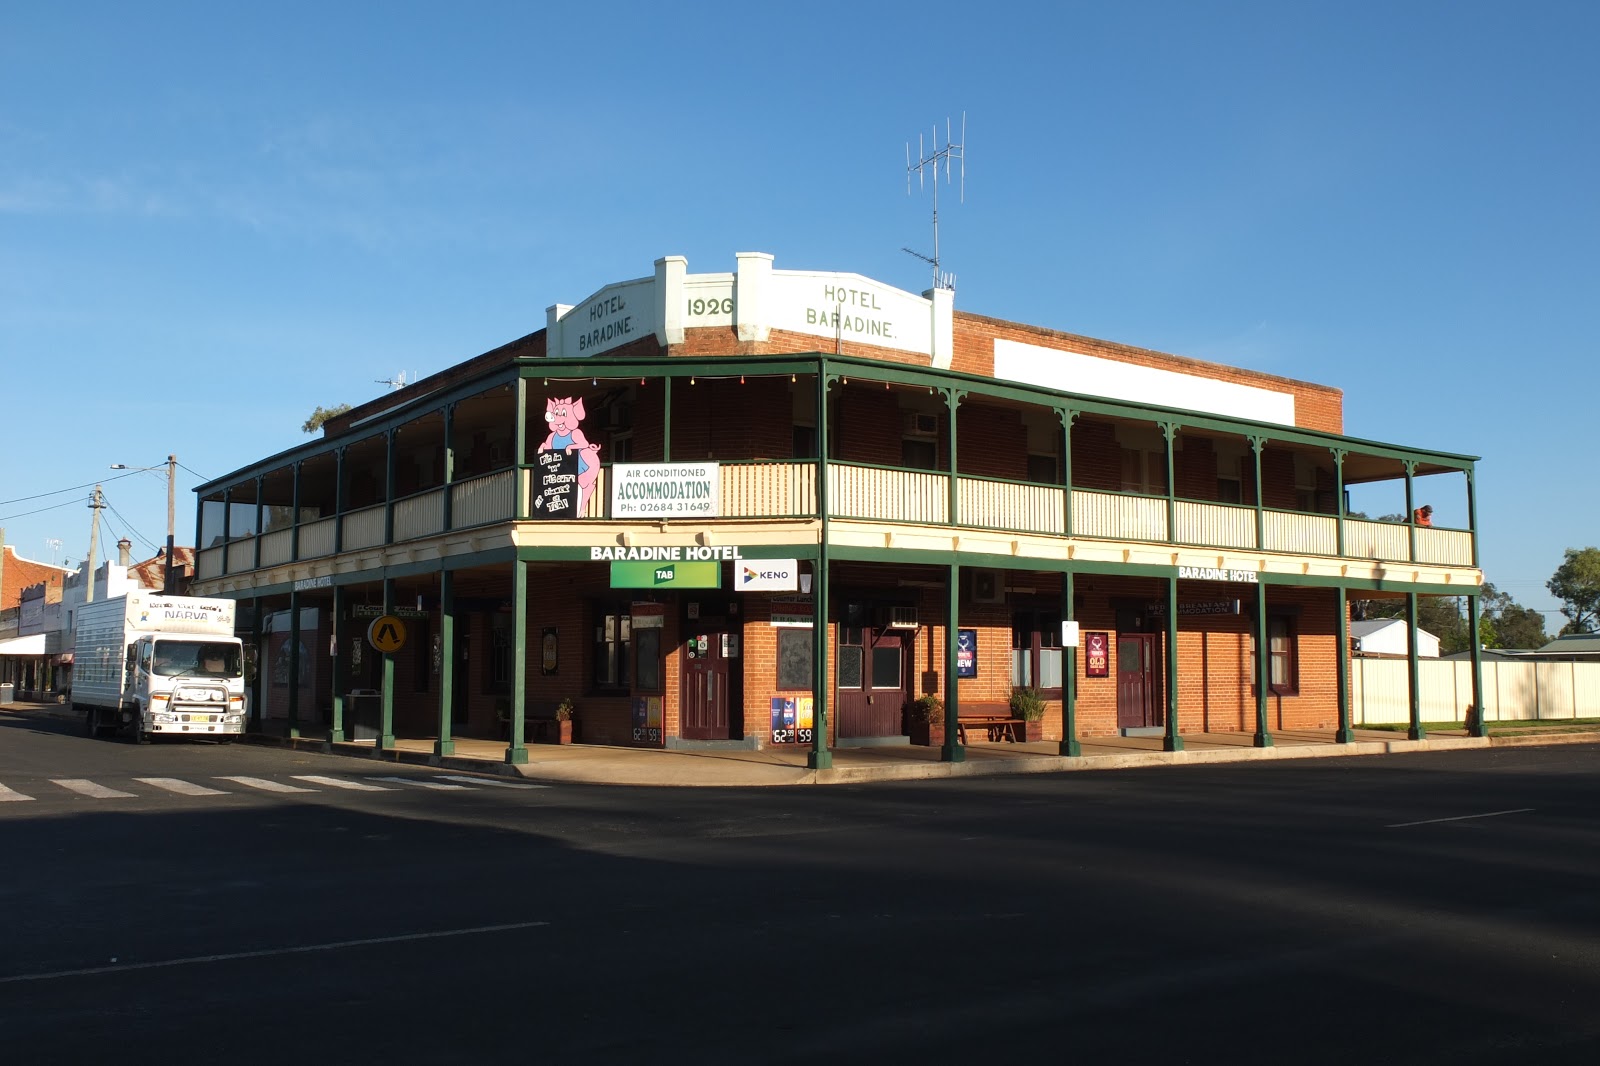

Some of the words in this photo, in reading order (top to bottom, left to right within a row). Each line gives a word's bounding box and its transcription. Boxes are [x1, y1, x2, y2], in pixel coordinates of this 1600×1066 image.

[825, 284, 881, 311] HOTEL
[589, 295, 625, 322] HOTEL
[687, 298, 734, 316] 1926
[626, 469, 641, 478] AIR
[643, 468, 706, 478] CONDITIONED
[617, 479, 711, 500] ACCOMMODATION
[620, 502, 637, 512] Ph:
[640, 502, 675, 513] 02684
[676, 501, 710, 512] 31649
[590, 546, 680, 561] BARADINE
[685, 545, 742, 560] HOTEL
[656, 569, 673, 580] TAB
[760, 570, 788, 580] KENO
[1178, 566, 1229, 581] BARADINE
[1230, 569, 1259, 583] HOTEL
[294, 577, 316, 592] BARADINE
[316, 575, 332, 588] HOTEL
[164, 610, 208, 621] NARVA
[1090, 657, 1105, 666] OLD
